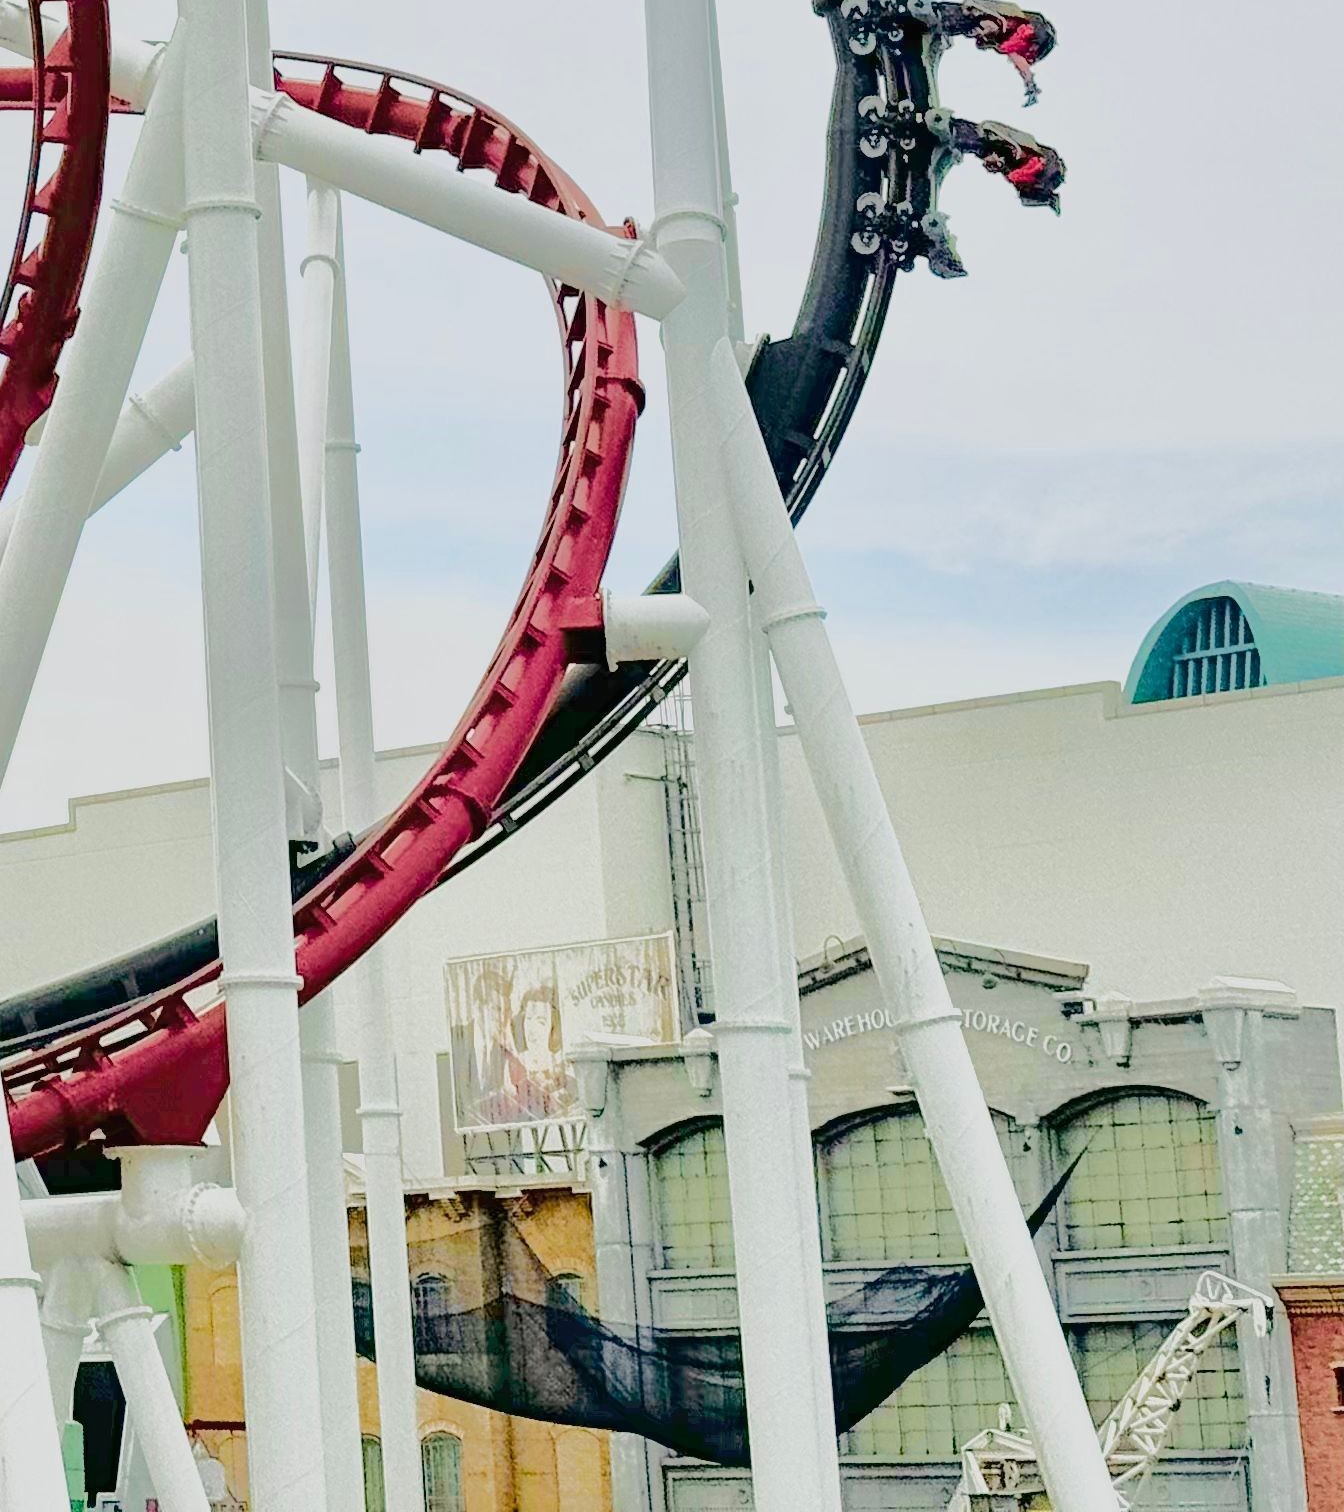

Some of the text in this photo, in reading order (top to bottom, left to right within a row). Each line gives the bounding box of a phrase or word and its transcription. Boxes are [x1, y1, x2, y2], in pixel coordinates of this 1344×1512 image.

[571, 963, 671, 1006] SUPERSTAR
[803, 1008, 900, 1050] WAREHOU
[961, 1008, 1039, 1047] TORAGE
